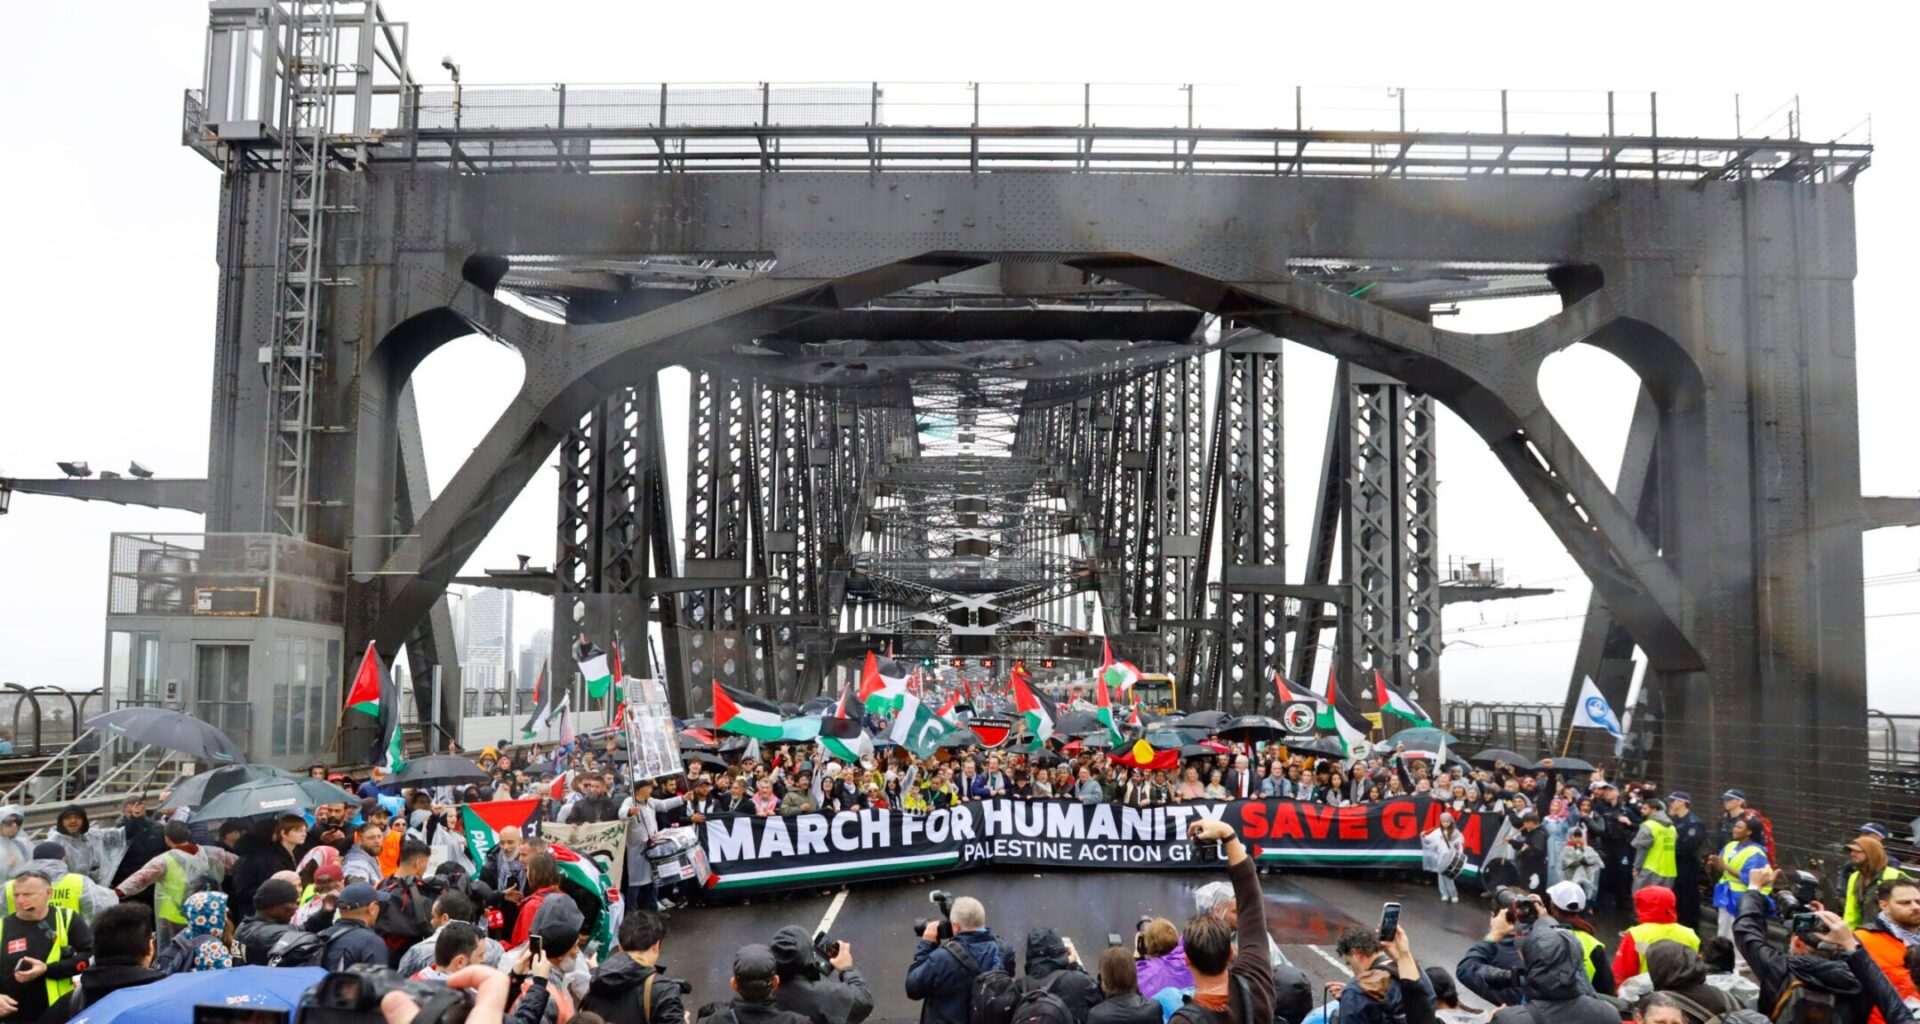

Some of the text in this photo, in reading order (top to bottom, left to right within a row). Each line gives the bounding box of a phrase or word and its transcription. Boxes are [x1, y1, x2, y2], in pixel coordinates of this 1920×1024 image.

[706, 799, 1482, 863] MARCH FOR HUMANITY SAVE GAA
[964, 839, 1073, 861] PALESTINE
[1078, 843, 1162, 862] ACTION
